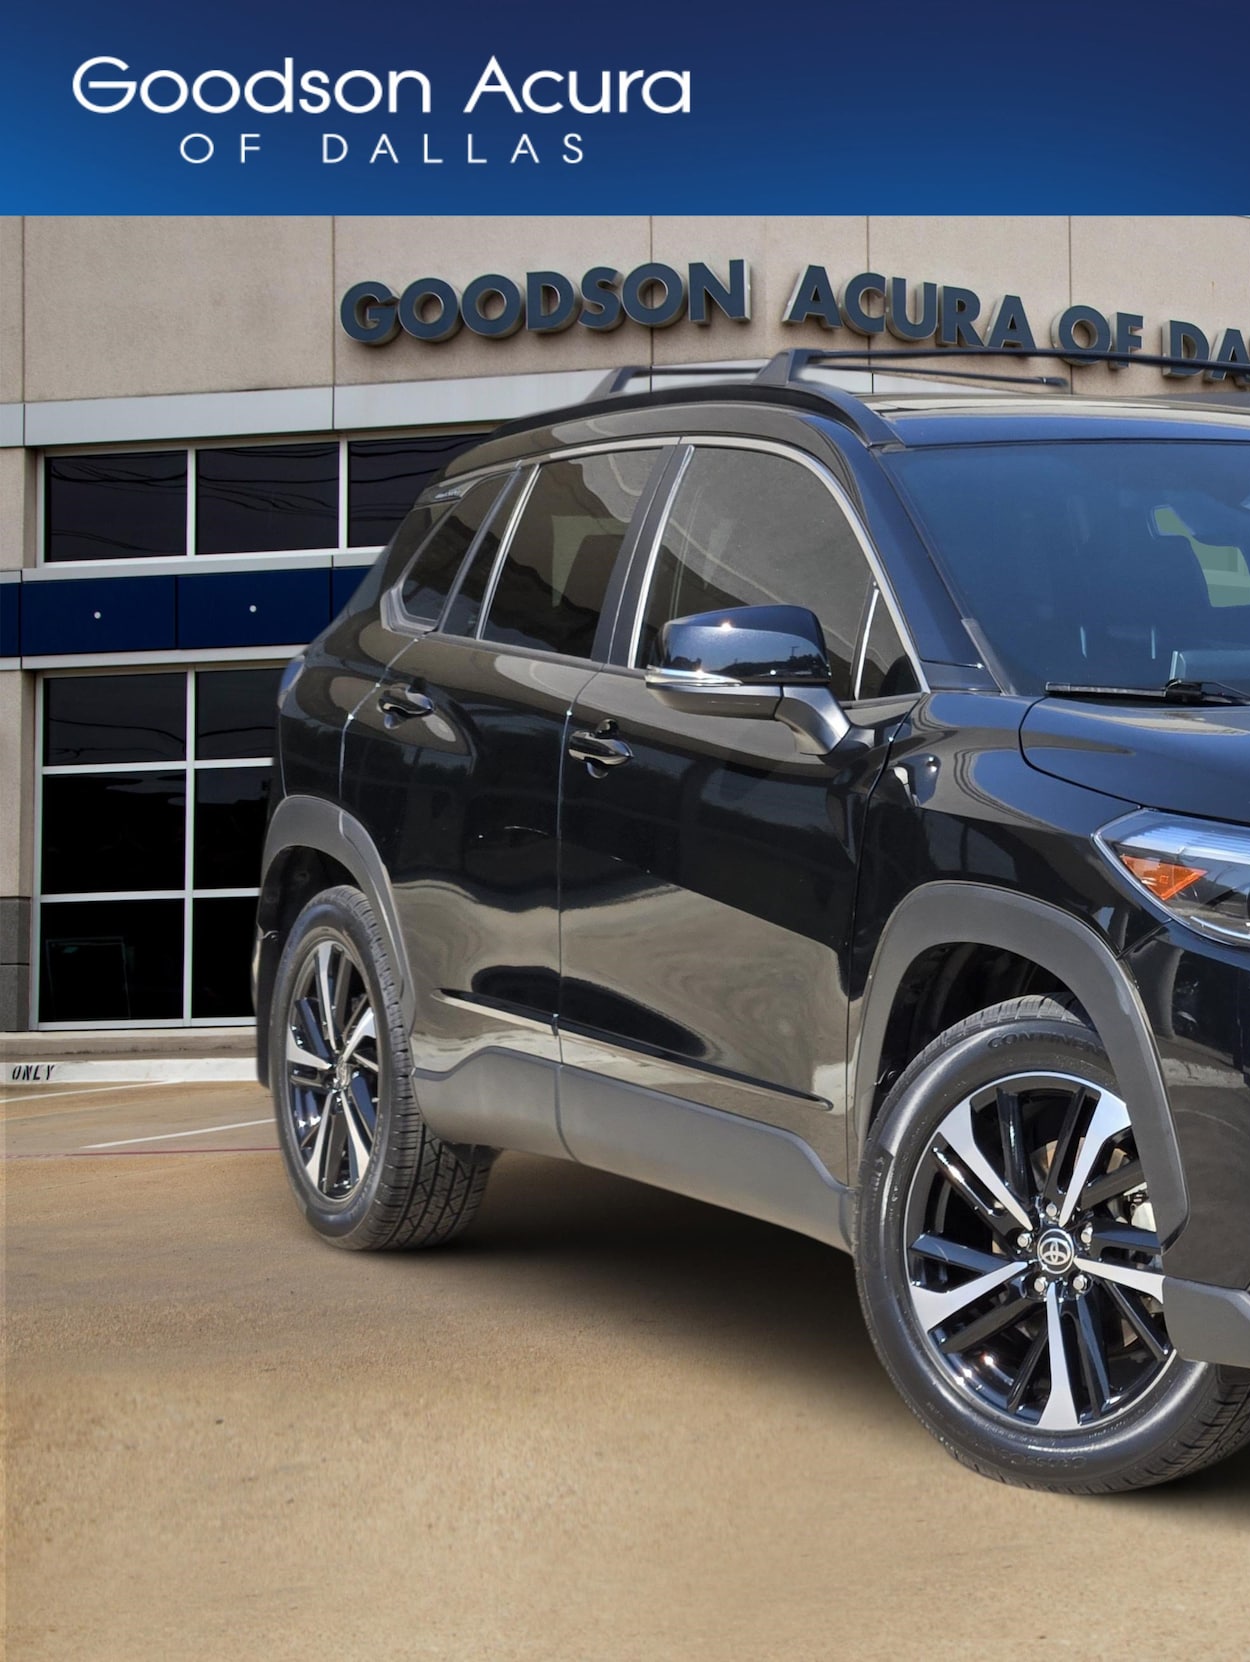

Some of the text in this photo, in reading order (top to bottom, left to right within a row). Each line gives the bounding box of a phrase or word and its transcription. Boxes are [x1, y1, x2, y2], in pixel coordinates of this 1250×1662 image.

[340, 259, 750, 345] GOODSON
[782, 264, 1037, 352] ACURA
[1051, 305, 1143, 370] OF
[12, 1064, 55, 1081] ONLY
